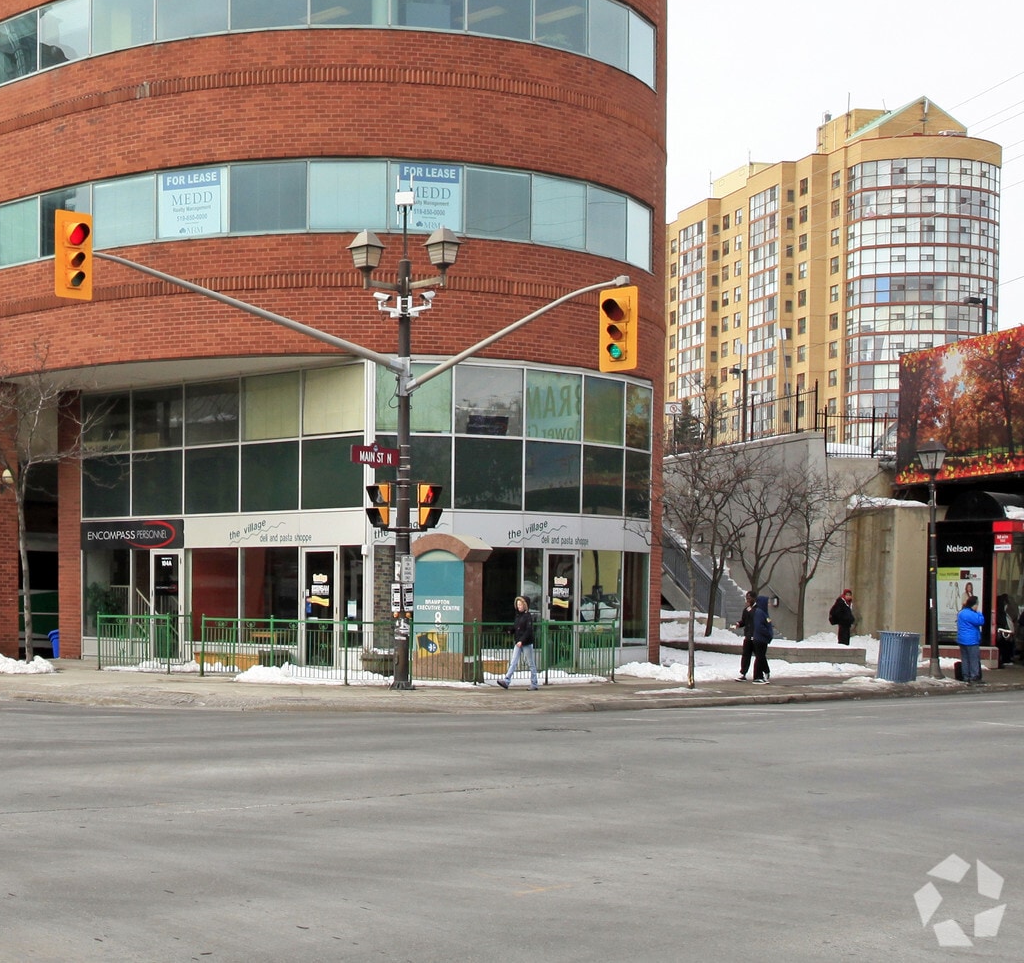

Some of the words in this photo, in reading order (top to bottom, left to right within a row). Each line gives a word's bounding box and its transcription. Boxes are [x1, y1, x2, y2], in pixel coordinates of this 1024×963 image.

[166, 175, 186, 186] FOR
[187, 171, 217, 184] LEASE
[403, 166, 423, 177] FOR
[425, 167, 456, 179] LEASE
[171, 190, 213, 206] MEDD
[359, 450, 375, 463] MAIN
[376, 452, 384, 464] ST
[386, 453, 392, 464] N
[87, 530, 136, 541] ENCOMPASS
[136, 529, 167, 539] PERSONNEL
[229, 529, 241, 540] the
[243, 519, 267, 534] village
[508, 529, 522, 540] the
[525, 520, 548, 534] village
[259, 534, 268, 542] deli
[269, 534, 278, 542] and
[279, 534, 293, 544] pasta
[294, 534, 312, 543] shoppe
[541, 536, 550, 544] deli
[551, 536, 560, 544] and
[560, 536, 574, 546] pasta
[574, 537, 589, 546] shoppe
[946, 544, 973, 553] Nelson
[434, 611, 442, 627] 8
